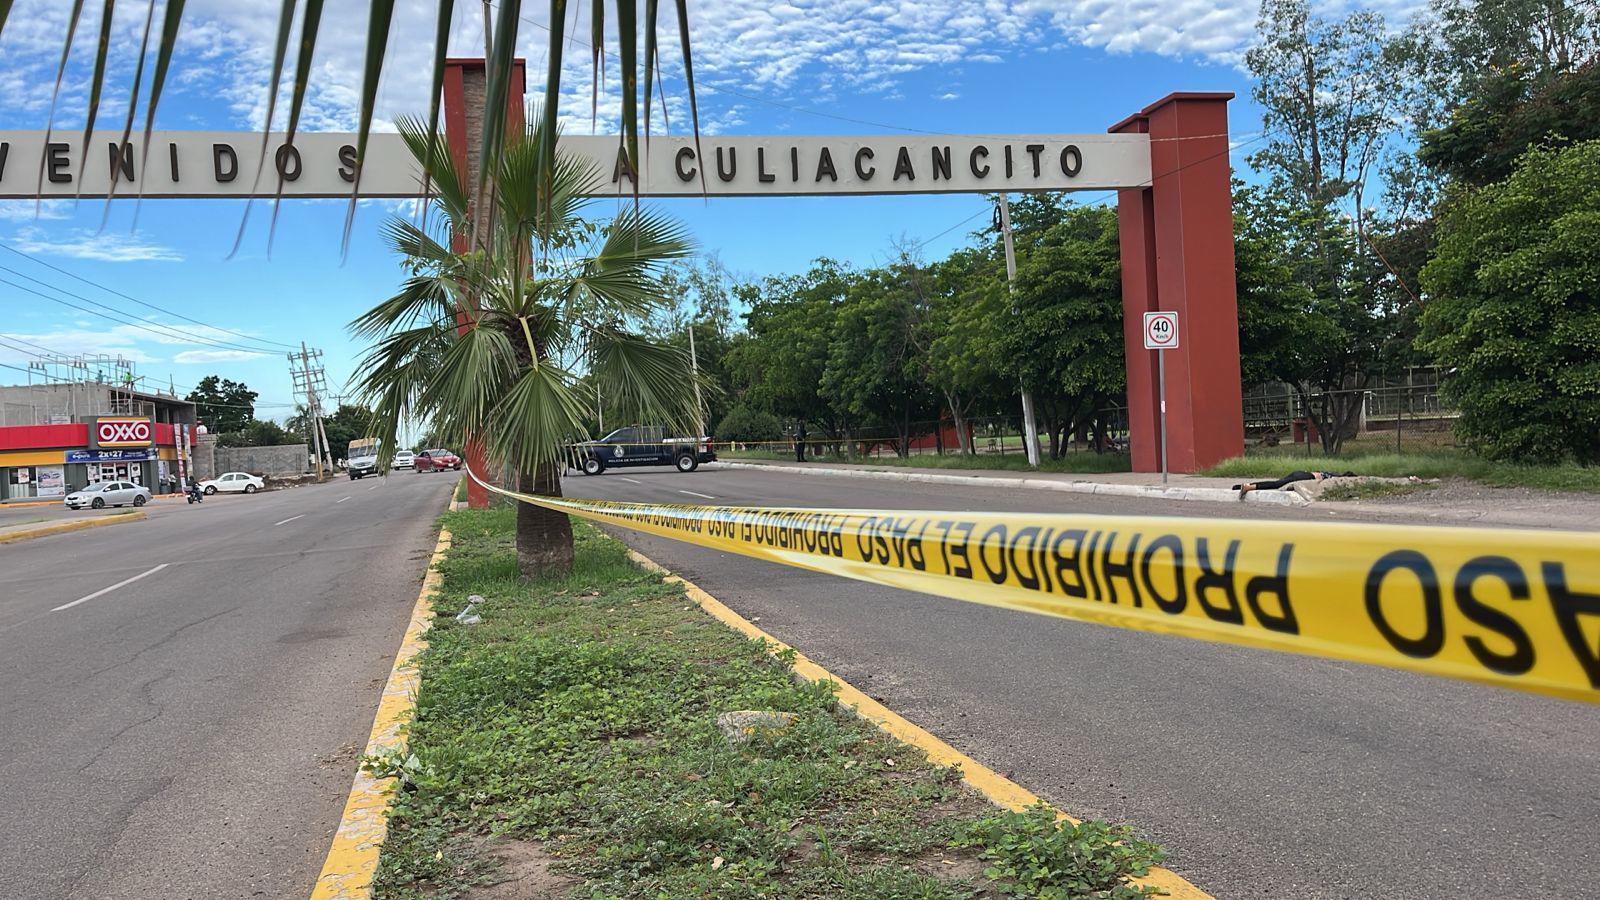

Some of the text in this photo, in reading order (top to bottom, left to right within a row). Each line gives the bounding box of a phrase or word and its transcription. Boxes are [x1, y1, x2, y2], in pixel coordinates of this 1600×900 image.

[612, 145, 637, 183] A
[675, 143, 1083, 183] CULIACANCITO
[1153, 320, 1168, 332] 40
[100, 421, 149, 442] OXXO
[707, 507, 744, 539] PASO
[740, 509, 760, 542] EL
[755, 510, 850, 557] PROHIBIDO
[857, 516, 930, 571] PASO
[936, 520, 976, 579] EL
[979, 523, 1300, 635] PROHIBIDO
